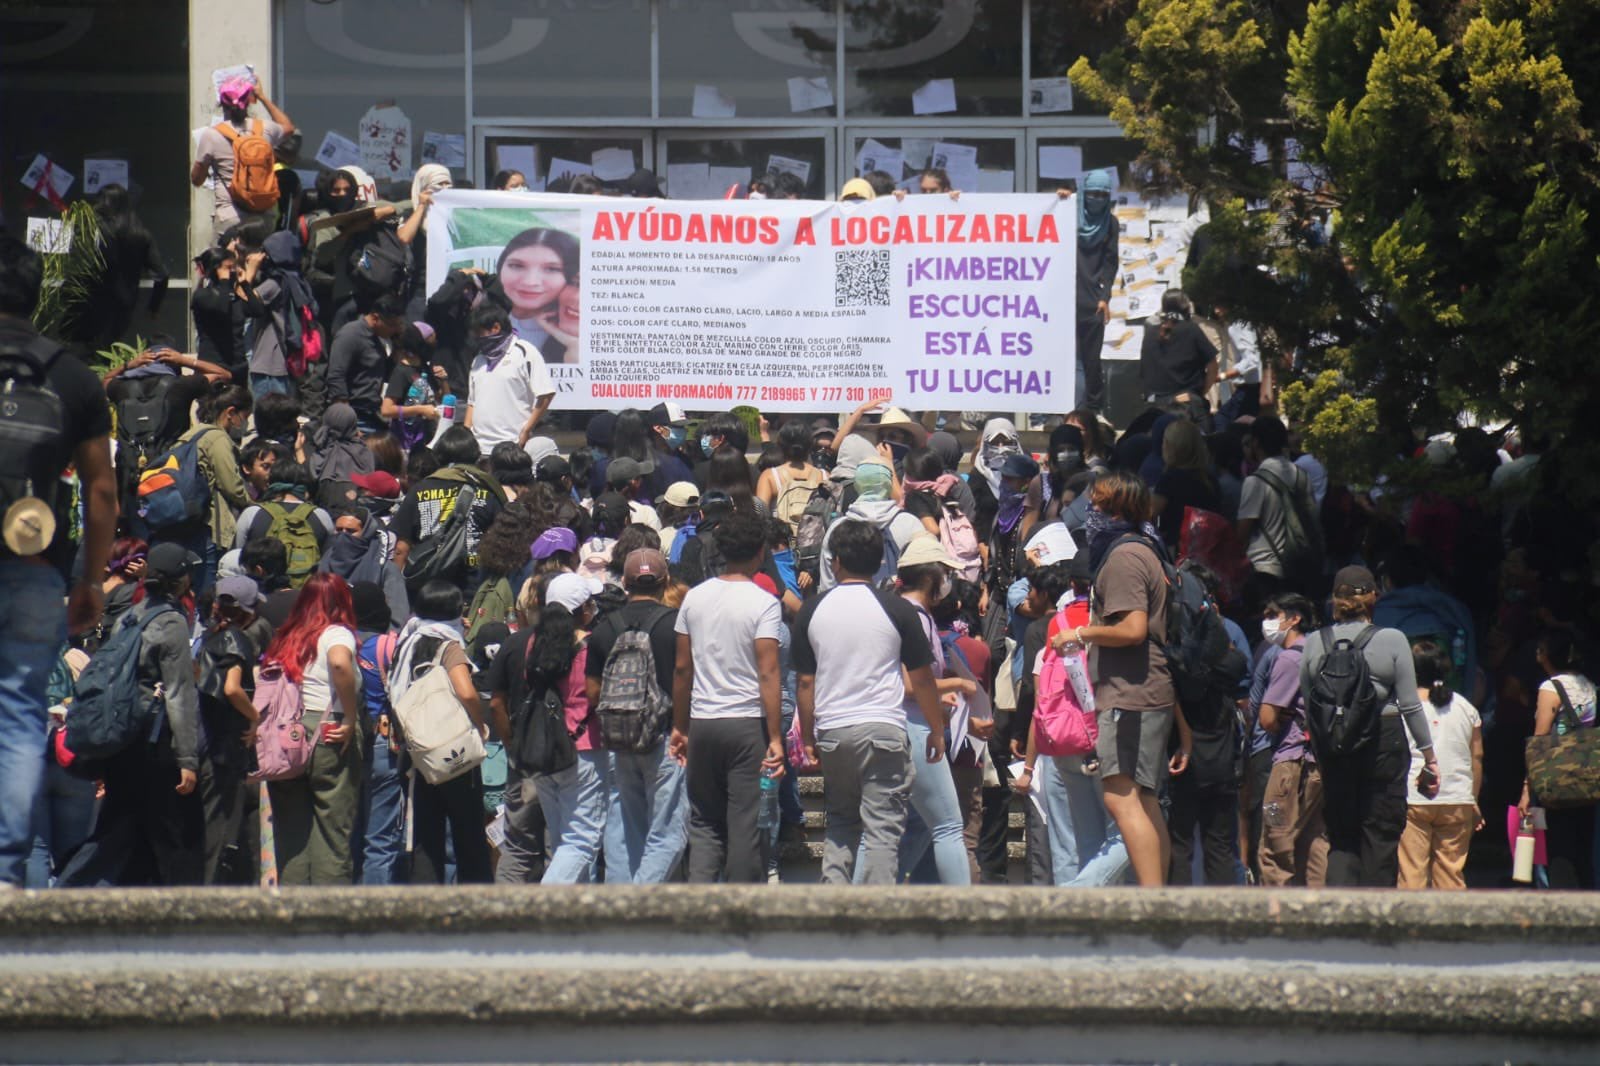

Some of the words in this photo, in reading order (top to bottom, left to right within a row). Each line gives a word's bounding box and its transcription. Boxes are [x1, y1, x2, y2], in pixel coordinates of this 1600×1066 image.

[592, 206, 779, 245] AYÚDANOS
[793, 217, 816, 245] A
[831, 214, 1060, 246] LOCALIZARLA
[628, 251, 670, 259] MOMENTO
[673, 252, 682, 260] DE
[625, 265, 682, 273] APROXIMADA:
[703, 267, 738, 275] METROS
[906, 256, 1051, 287] ¡KIMBERLY
[591, 277, 648, 286] COMPLEXIÓN:
[611, 292, 645, 300] BLANCA
[591, 305, 631, 313] CABELLO:
[663, 305, 702, 314] CASTAÑO
[704, 307, 735, 316] CLARO,
[736, 308, 764, 317] LACIO,
[831, 309, 867, 318] ESPALDA
[909, 294, 1048, 322] ESCUCHA,
[590, 319, 615, 327] OJOS:
[647, 318, 669, 327] CAFÉ
[671, 320, 701, 329] CLARO,
[703, 321, 747, 329] MEDIANOS
[706, 335, 752, 343] MEZCLILLA
[754, 336, 782, 344] COLOR
[807, 337, 844, 345] OSCURO,
[846, 336, 891, 344] CHAMARRA
[925, 327, 991, 356] ESTÁ
[1001, 332, 1033, 356] ES
[700, 341, 722, 349] AZUL
[723, 342, 757, 350] MARINO
[759, 343, 776, 351] CON
[778, 344, 808, 352] CIERRE
[840, 343, 863, 351] GRIS,
[647, 347, 684, 355] BLANCO,
[715, 348, 727, 356] DE
[729, 349, 753, 357] MANO
[754, 350, 788, 358] GRANDE
[834, 350, 863, 358] NEGRO
[590, 359, 618, 367] SEÑAS
[620, 360, 684, 369] PARTICULARES:
[763, 363, 810, 371] IZQUIERDA,
[812, 363, 870, 372] PERFORACIÓN
[550, 368, 583, 378] ELIN
[590, 374, 612, 382] LADO
[614, 374, 661, 382] IZQUIERDO
[621, 367, 651, 375] CEJAS,
[760, 370, 796, 378] CABEZA,
[828, 370, 871, 378] ENCIMADA
[558, 380, 575, 392] ÁN
[906, 370, 939, 394] TU
[949, 370, 1051, 394] LUCHA!
[591, 384, 652, 398] CUALQUIER
[656, 382, 733, 400] INFORMACIÓN
[736, 386, 758, 400] 777
[761, 387, 806, 401] 2189965
[810, 388, 819, 401] Y
[822, 388, 843, 401] 777
[846, 388, 865, 401] 310
